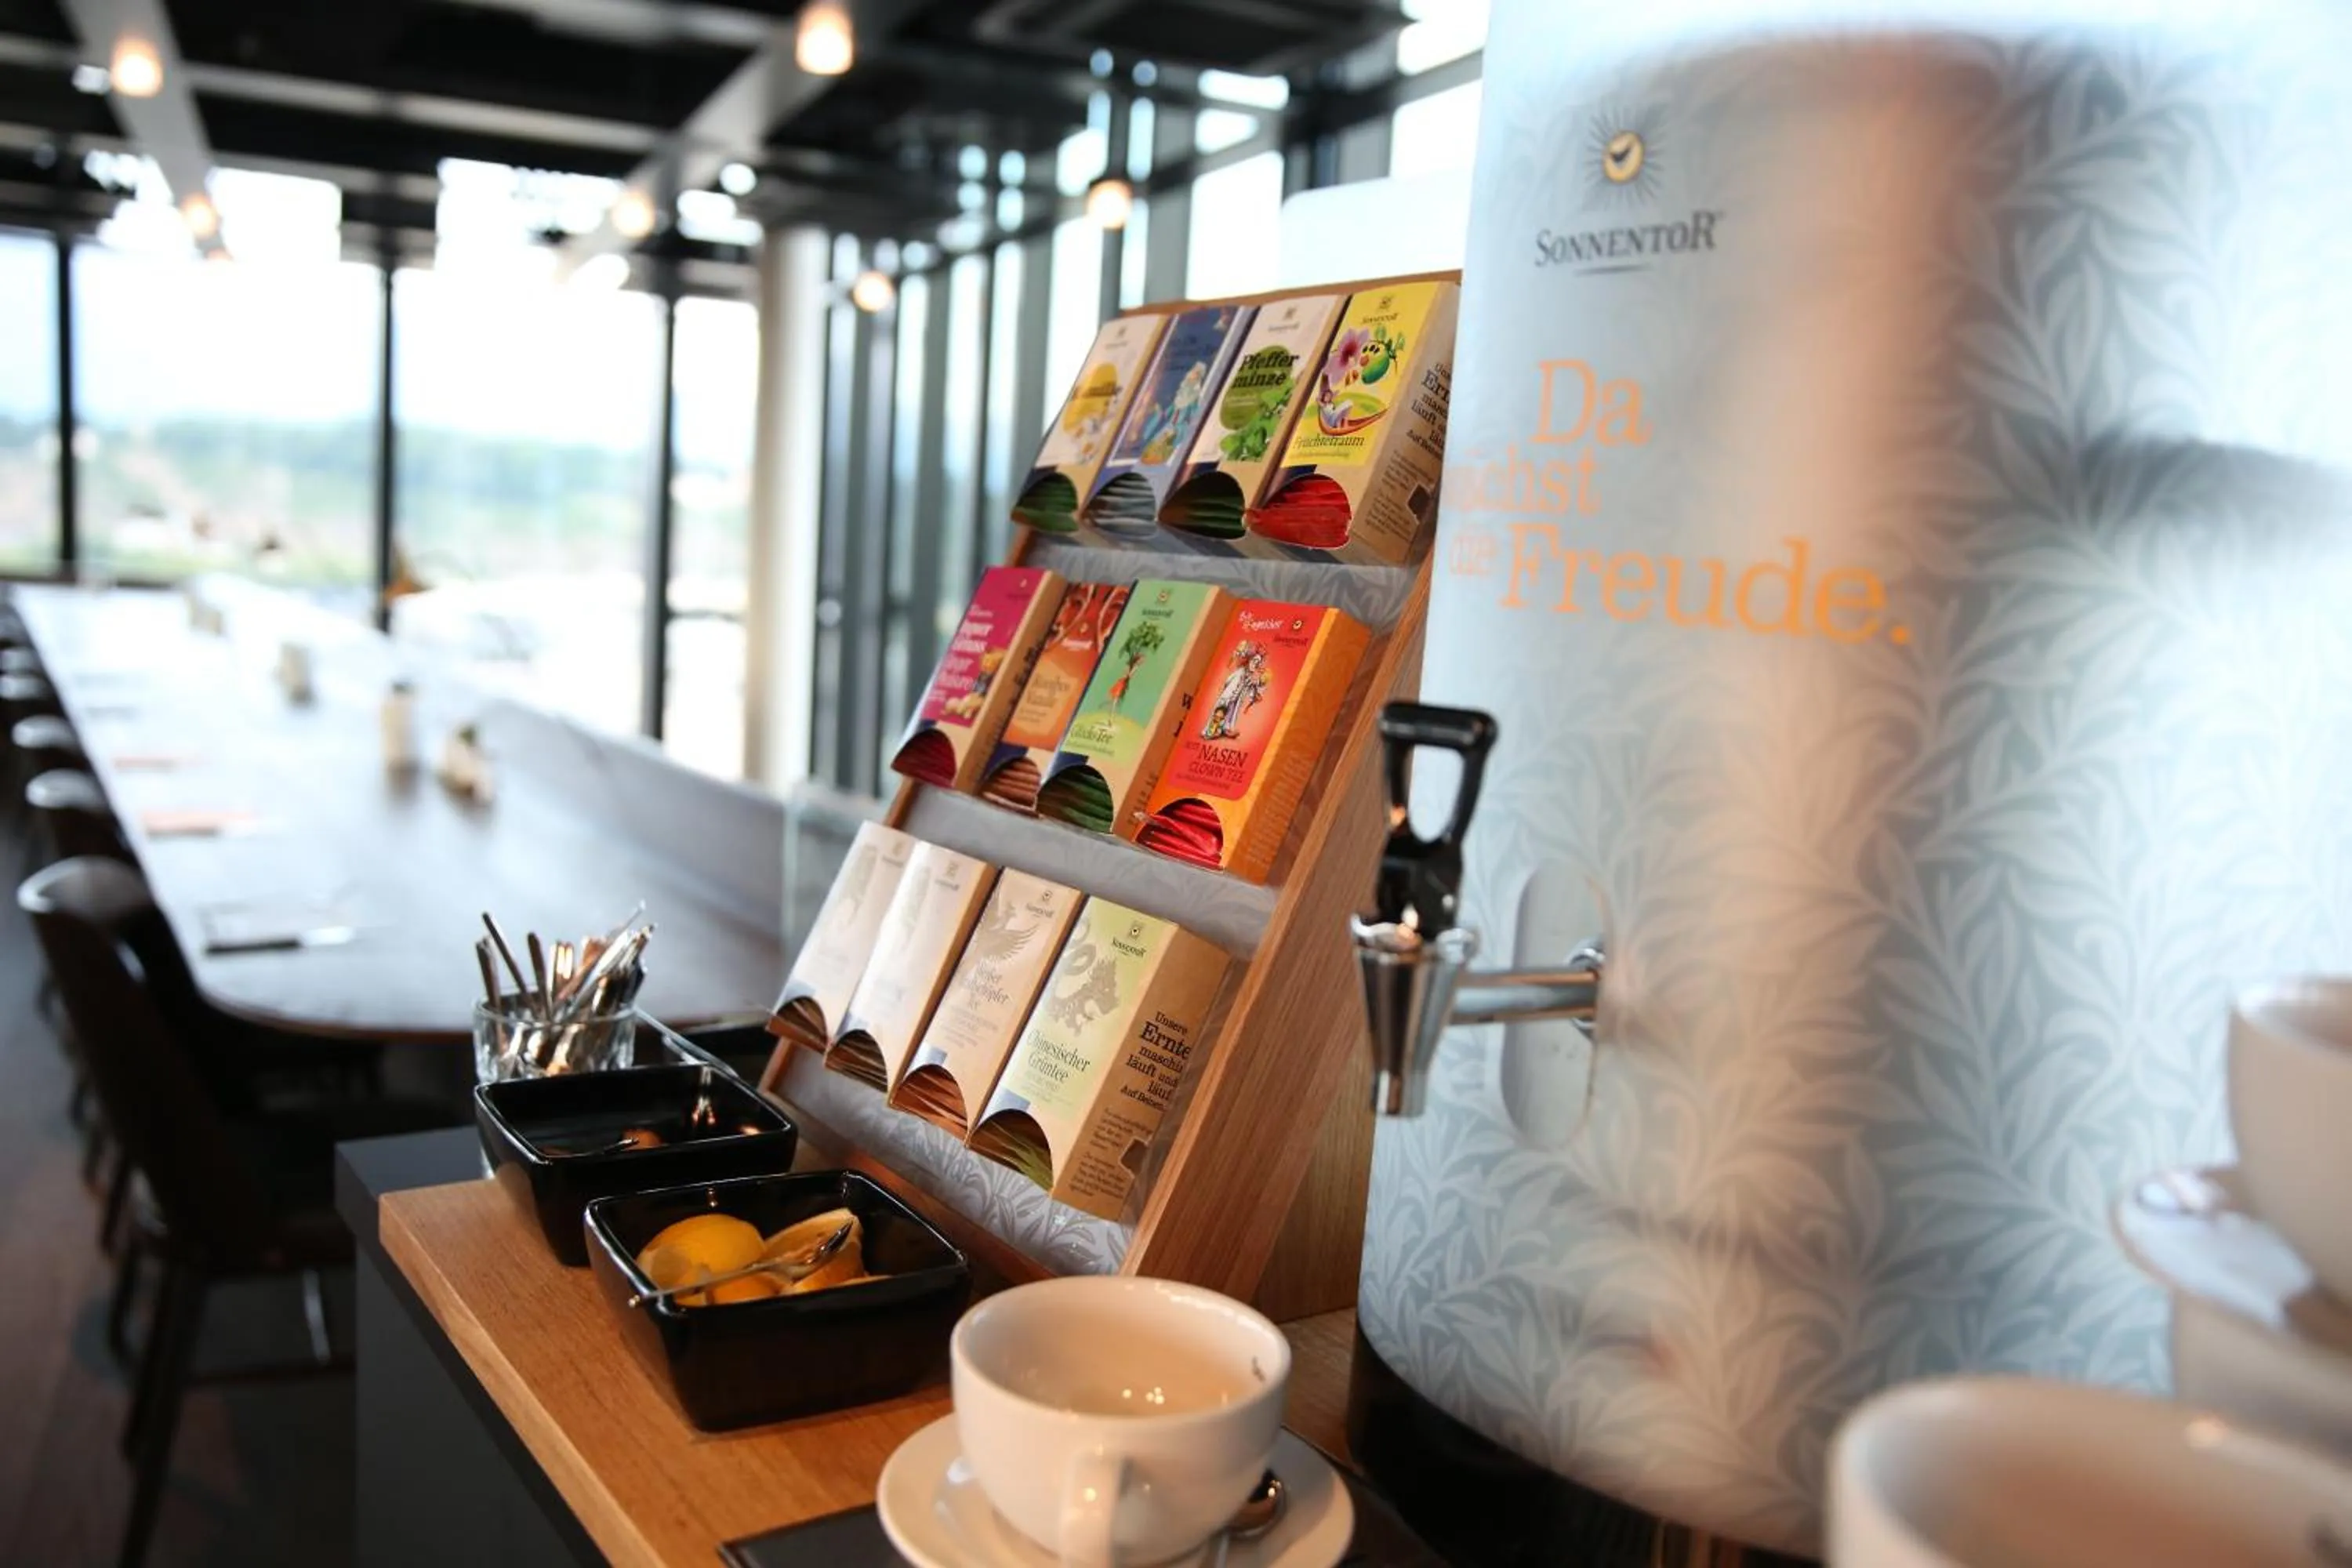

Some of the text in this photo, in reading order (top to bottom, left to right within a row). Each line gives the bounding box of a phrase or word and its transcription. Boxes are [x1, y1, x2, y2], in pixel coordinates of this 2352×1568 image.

[1534, 209, 1719, 267] SONNENTOR
[1230, 372, 1286, 389] minze
[1238, 350, 1300, 372] Pfeffer
[1530, 358, 1652, 446] Da
[1499, 522, 1912, 646] Freude.
[1199, 744, 1249, 768] NASEN
[1028, 1029, 1091, 1073] Chinesischer
[1139, 1021, 1192, 1060] Ernte
[1126, 1054, 1156, 1078] läuft
